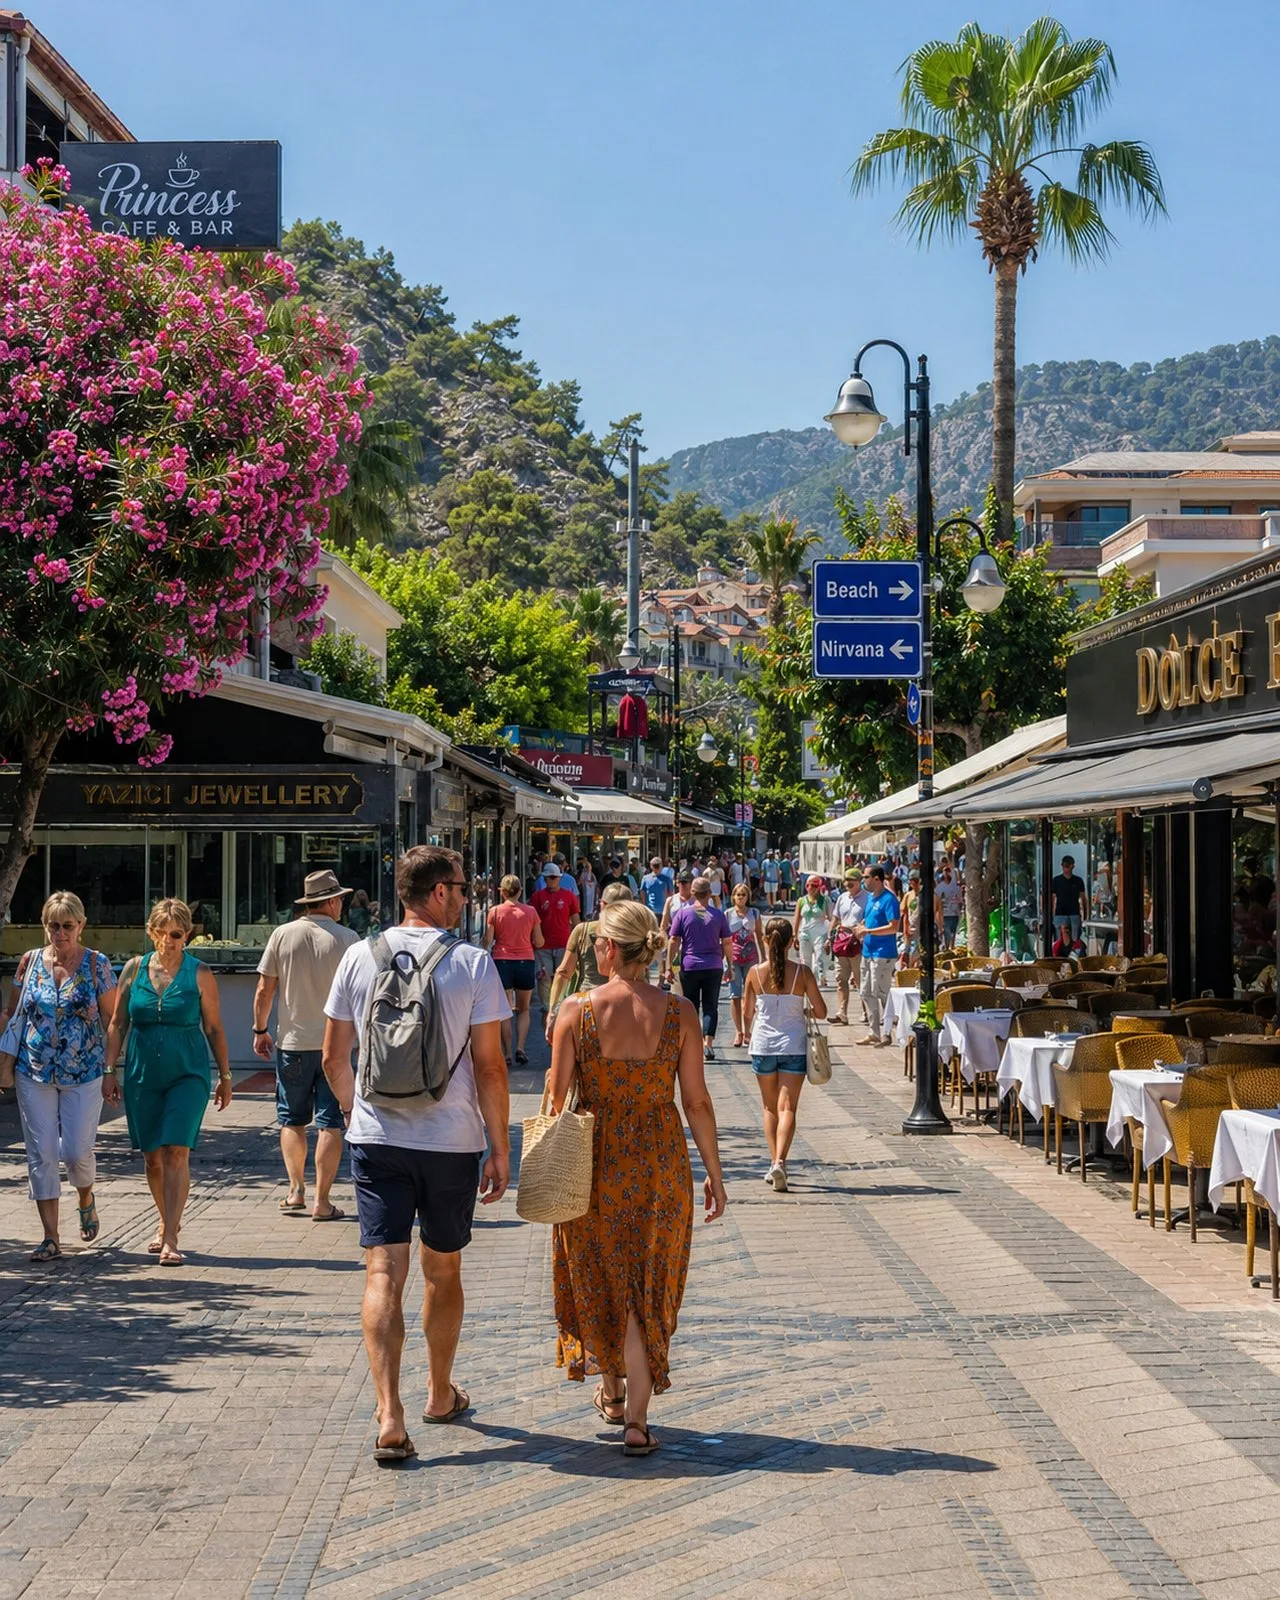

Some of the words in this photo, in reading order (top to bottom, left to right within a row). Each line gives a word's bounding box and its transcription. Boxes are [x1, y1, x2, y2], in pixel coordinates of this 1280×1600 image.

[98, 162, 241, 216] Princess
[101, 220, 157, 236] CAFE
[167, 220, 180, 236] &
[190, 220, 233, 236] BAR
[826, 581, 878, 598] Beach
[821, 640, 884, 657] Nirvana
[1136, 631, 1244, 715] DOLCE
[82, 784, 171, 805] YAZICI
[184, 784, 349, 806] JEWELLERY
